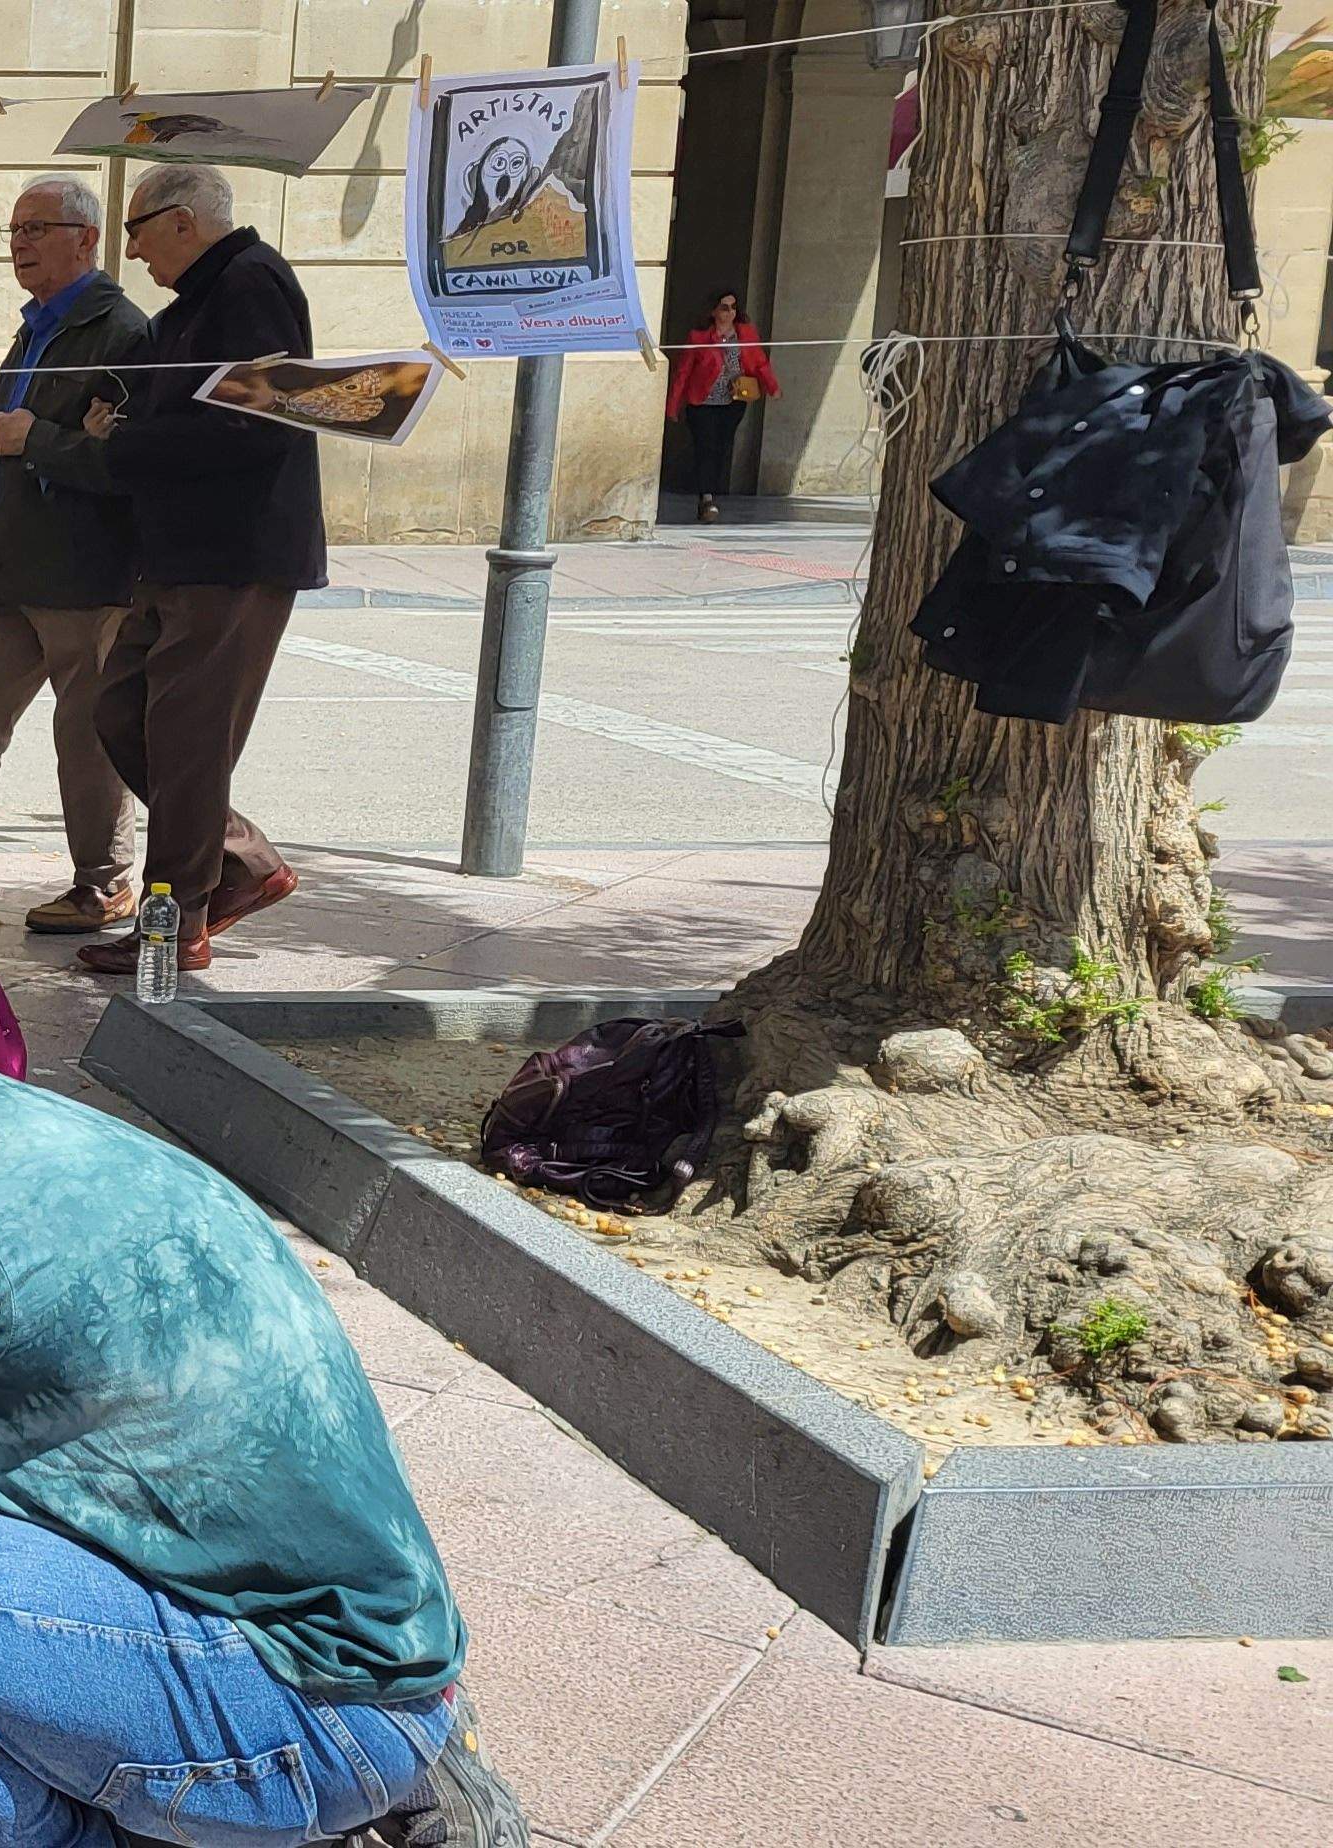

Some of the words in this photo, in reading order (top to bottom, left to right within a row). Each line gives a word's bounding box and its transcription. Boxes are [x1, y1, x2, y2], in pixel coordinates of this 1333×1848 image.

[458, 92, 568, 142] ARTISTAS
[490, 241, 532, 256] POR
[451, 272, 522, 289] CANAL
[531, 269, 584, 286] ROYA
[556, 318, 565, 328] a
[568, 313, 628, 328] dibujar!
